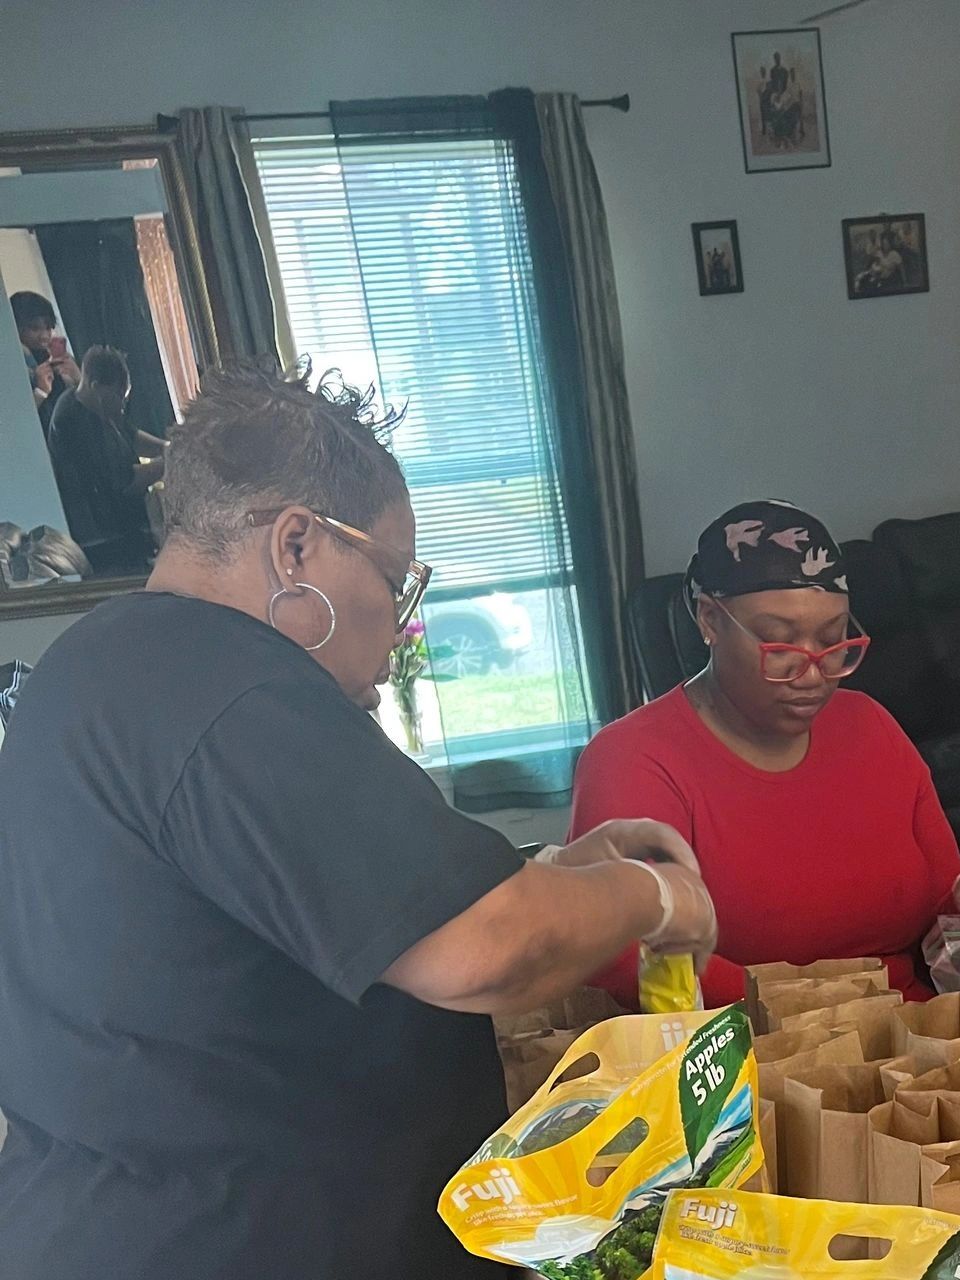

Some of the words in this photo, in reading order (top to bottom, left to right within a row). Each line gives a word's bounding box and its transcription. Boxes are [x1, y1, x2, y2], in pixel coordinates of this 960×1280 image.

[685, 1027, 735, 1080] Apples
[691, 1078, 707, 1106] 5
[704, 1063, 725, 1092] lb
[451, 1167, 521, 1212] Fuji
[680, 1198, 738, 1231] Fuji
